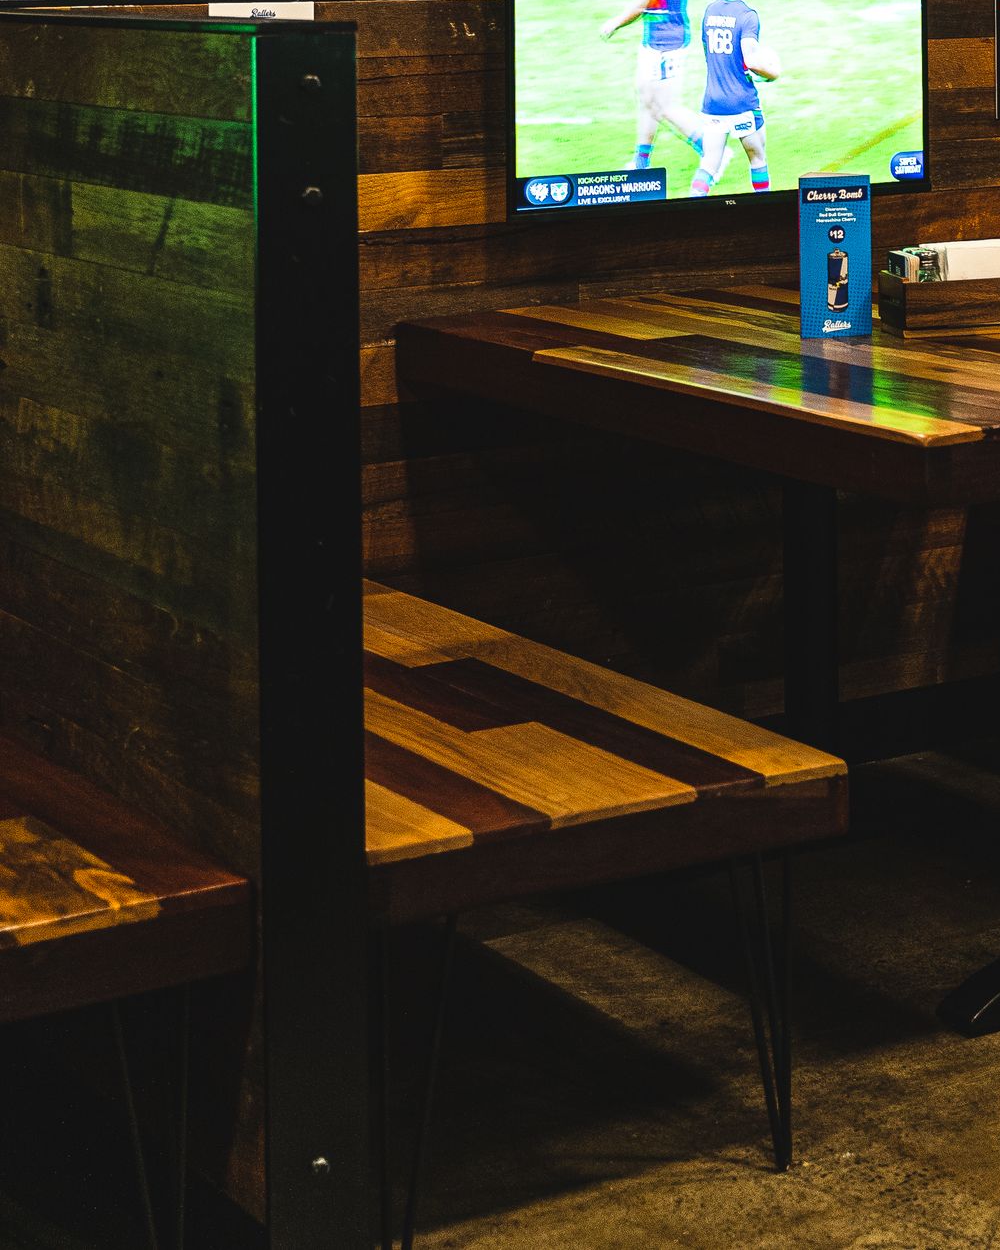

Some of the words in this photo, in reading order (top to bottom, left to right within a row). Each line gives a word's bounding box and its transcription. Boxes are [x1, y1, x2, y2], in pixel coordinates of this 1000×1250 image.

[706, 28, 734, 55] 168
[894, 164, 922, 175] SATURDAY
[577, 175, 609, 185] KICK-OFF
[609, 174, 629, 183] NEXT
[577, 184, 615, 197] DRAGONS
[622, 180, 661, 194] WARRIORS
[577, 197, 591, 205] LIVE
[597, 195, 631, 204] EXCLUSIVE
[806, 189, 838, 203] Cherry
[838, 188, 863, 199] Bomb
[829, 229, 844, 239] $12
